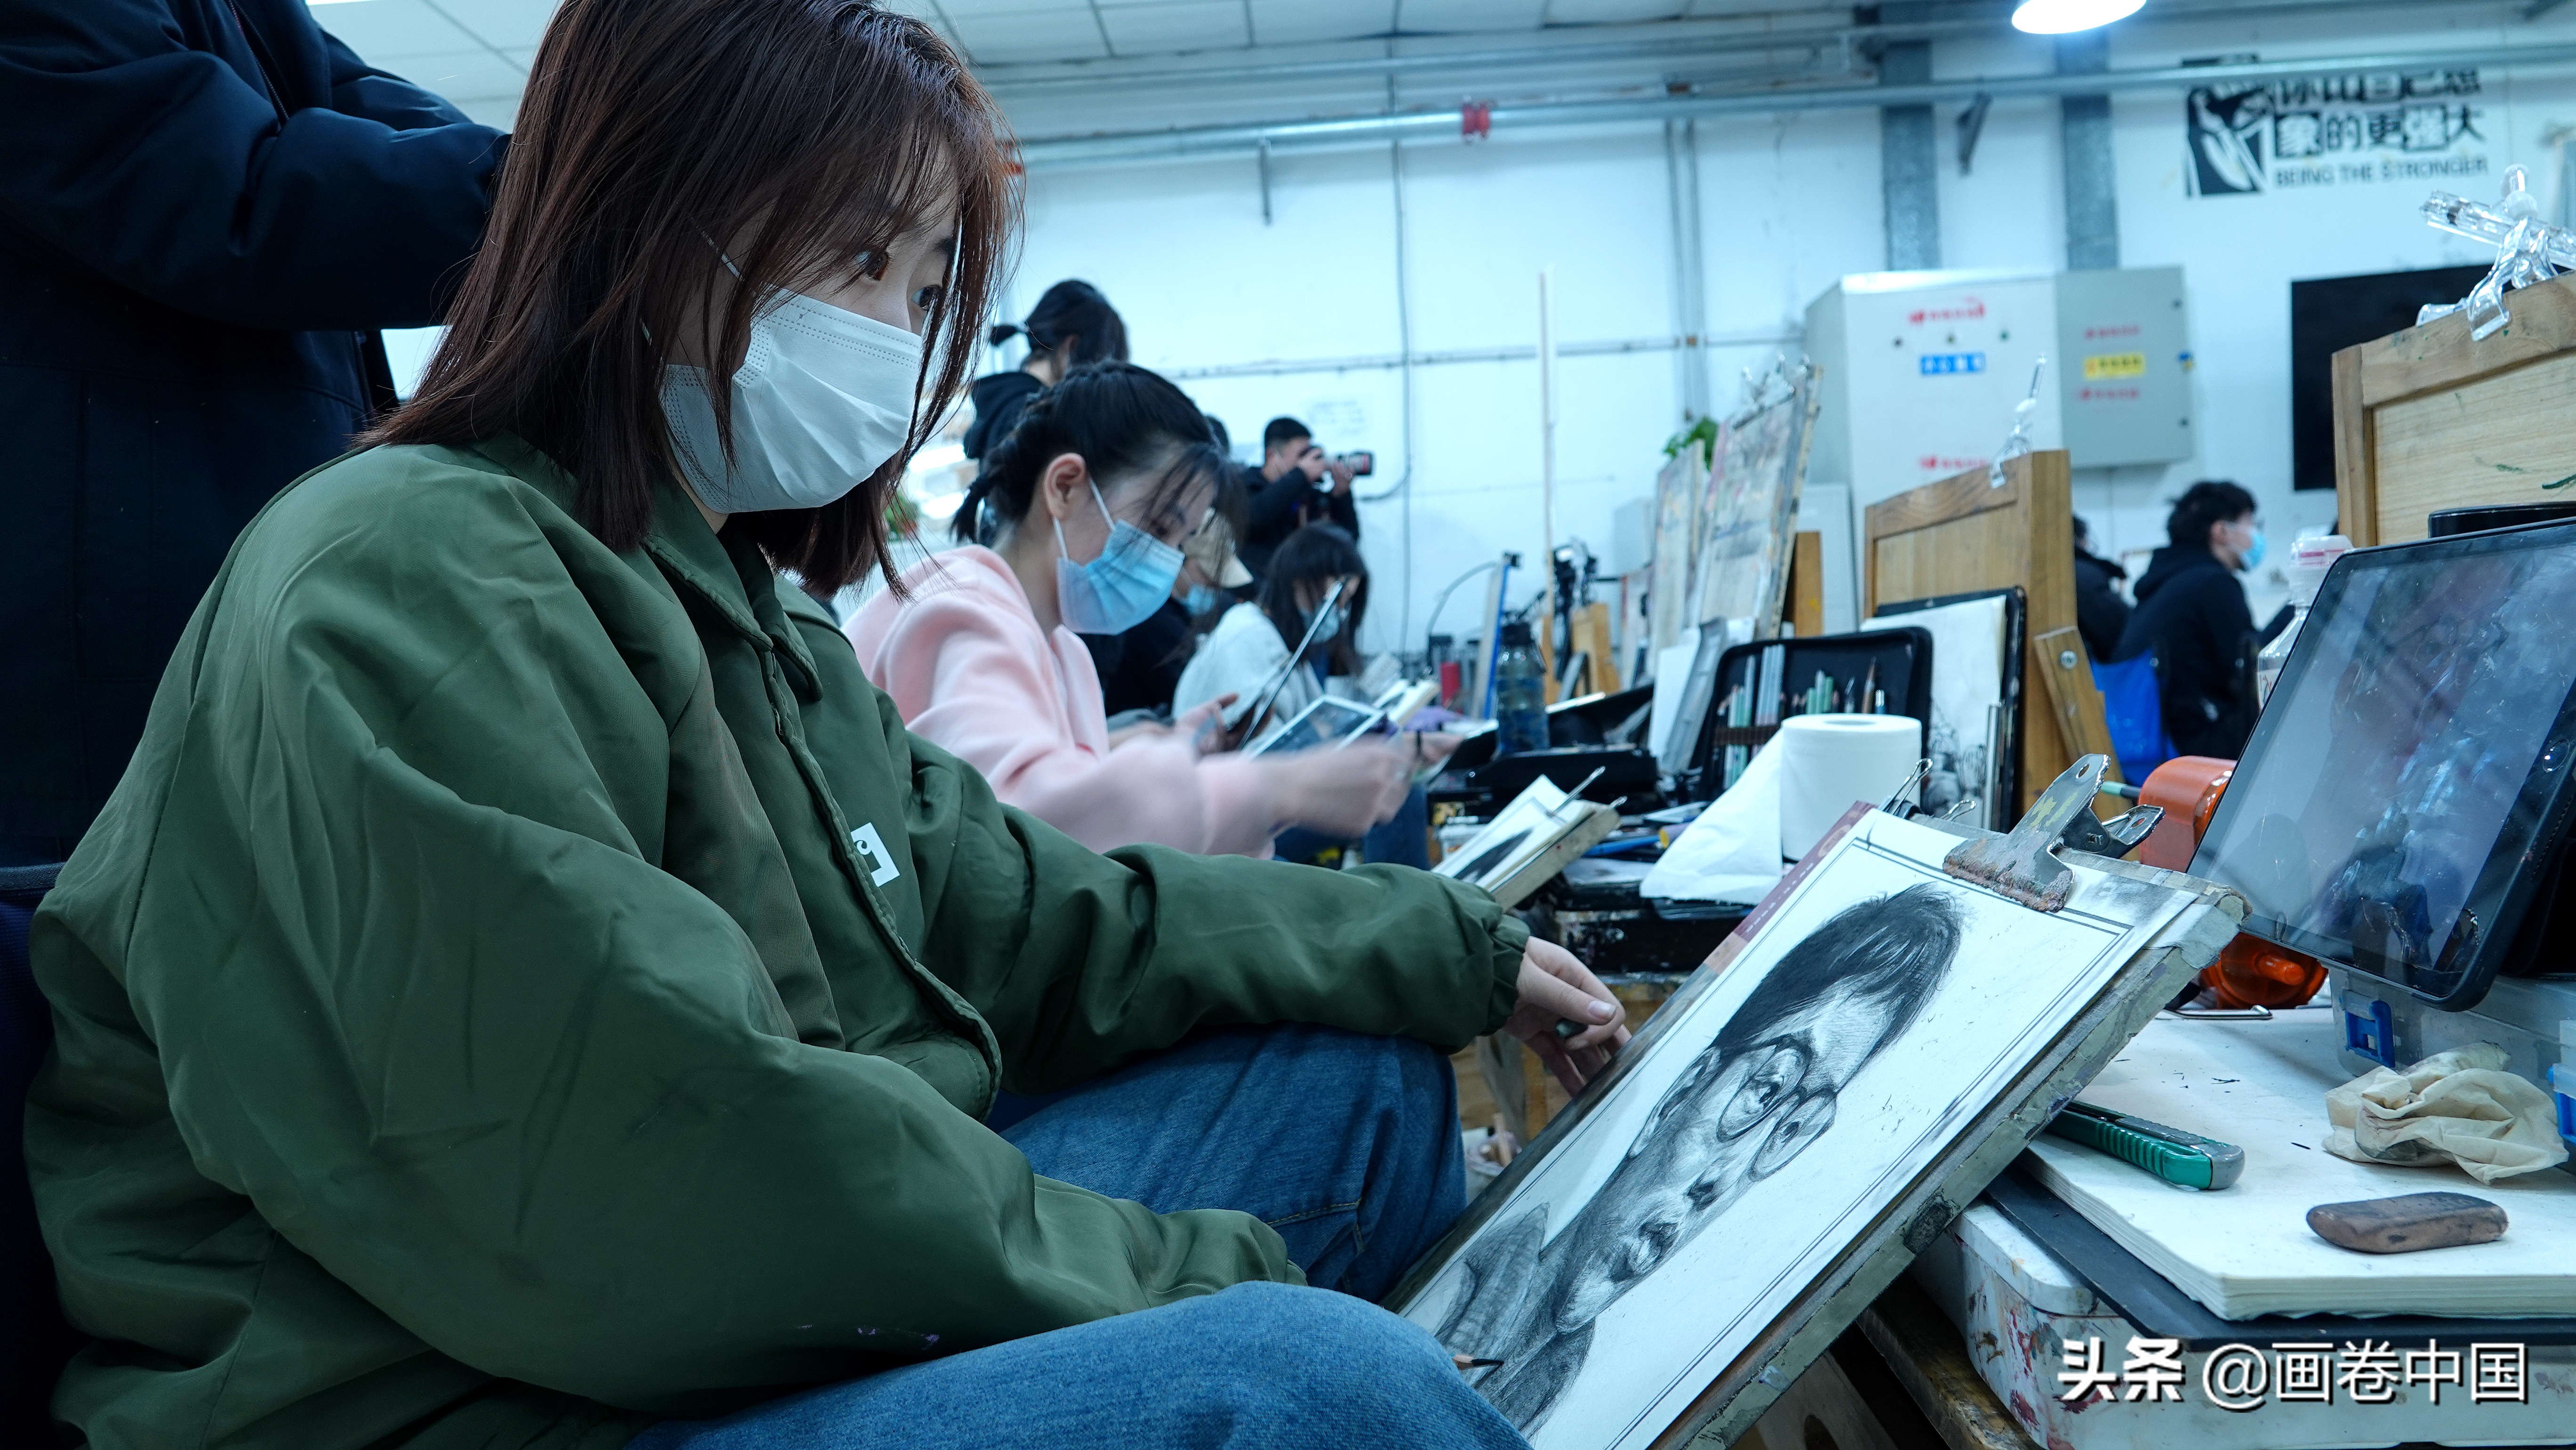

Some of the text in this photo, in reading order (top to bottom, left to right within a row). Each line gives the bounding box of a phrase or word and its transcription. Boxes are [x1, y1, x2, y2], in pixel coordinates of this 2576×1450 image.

[2276, 156, 2489, 186] BEING THE STRONGER
